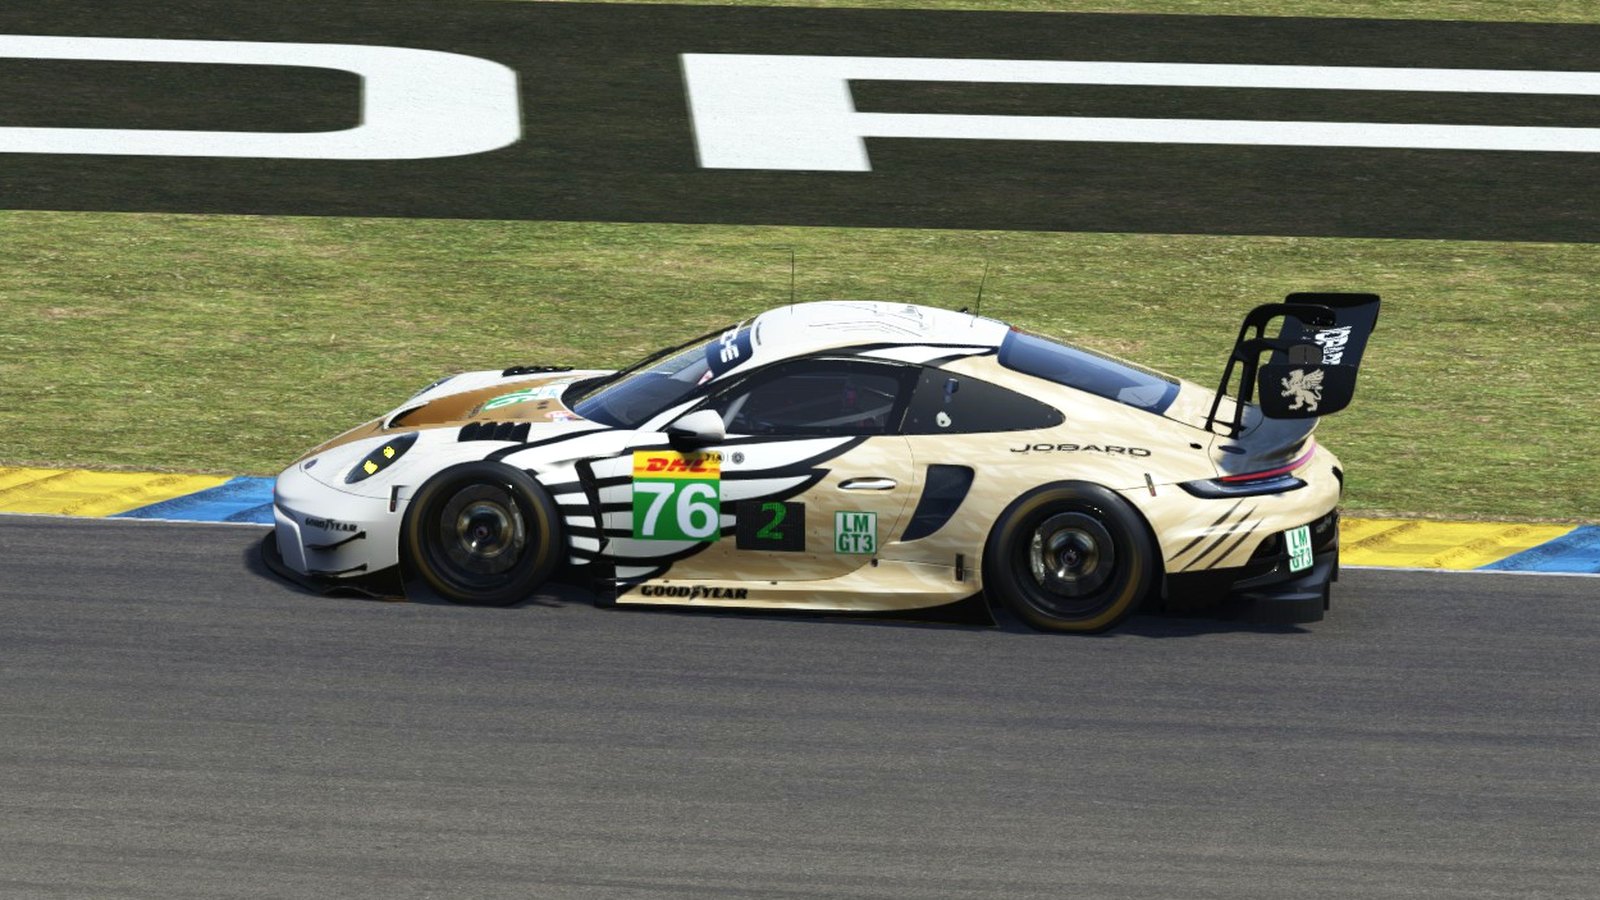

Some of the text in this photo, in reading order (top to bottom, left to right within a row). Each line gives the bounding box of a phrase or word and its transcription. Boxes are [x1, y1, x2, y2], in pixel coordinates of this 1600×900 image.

[1010, 443, 1152, 457] JOBARD
[646, 458, 707, 473] DHL
[634, 482, 719, 538] 76
[305, 516, 358, 533] GOODYEAR
[756, 501, 787, 540] 2
[842, 514, 869, 533] LM
[838, 533, 874, 552] GT3
[1291, 528, 1308, 550] LM
[1292, 547, 1312, 569] GT3
[640, 583, 749, 600] GOODYEAR
